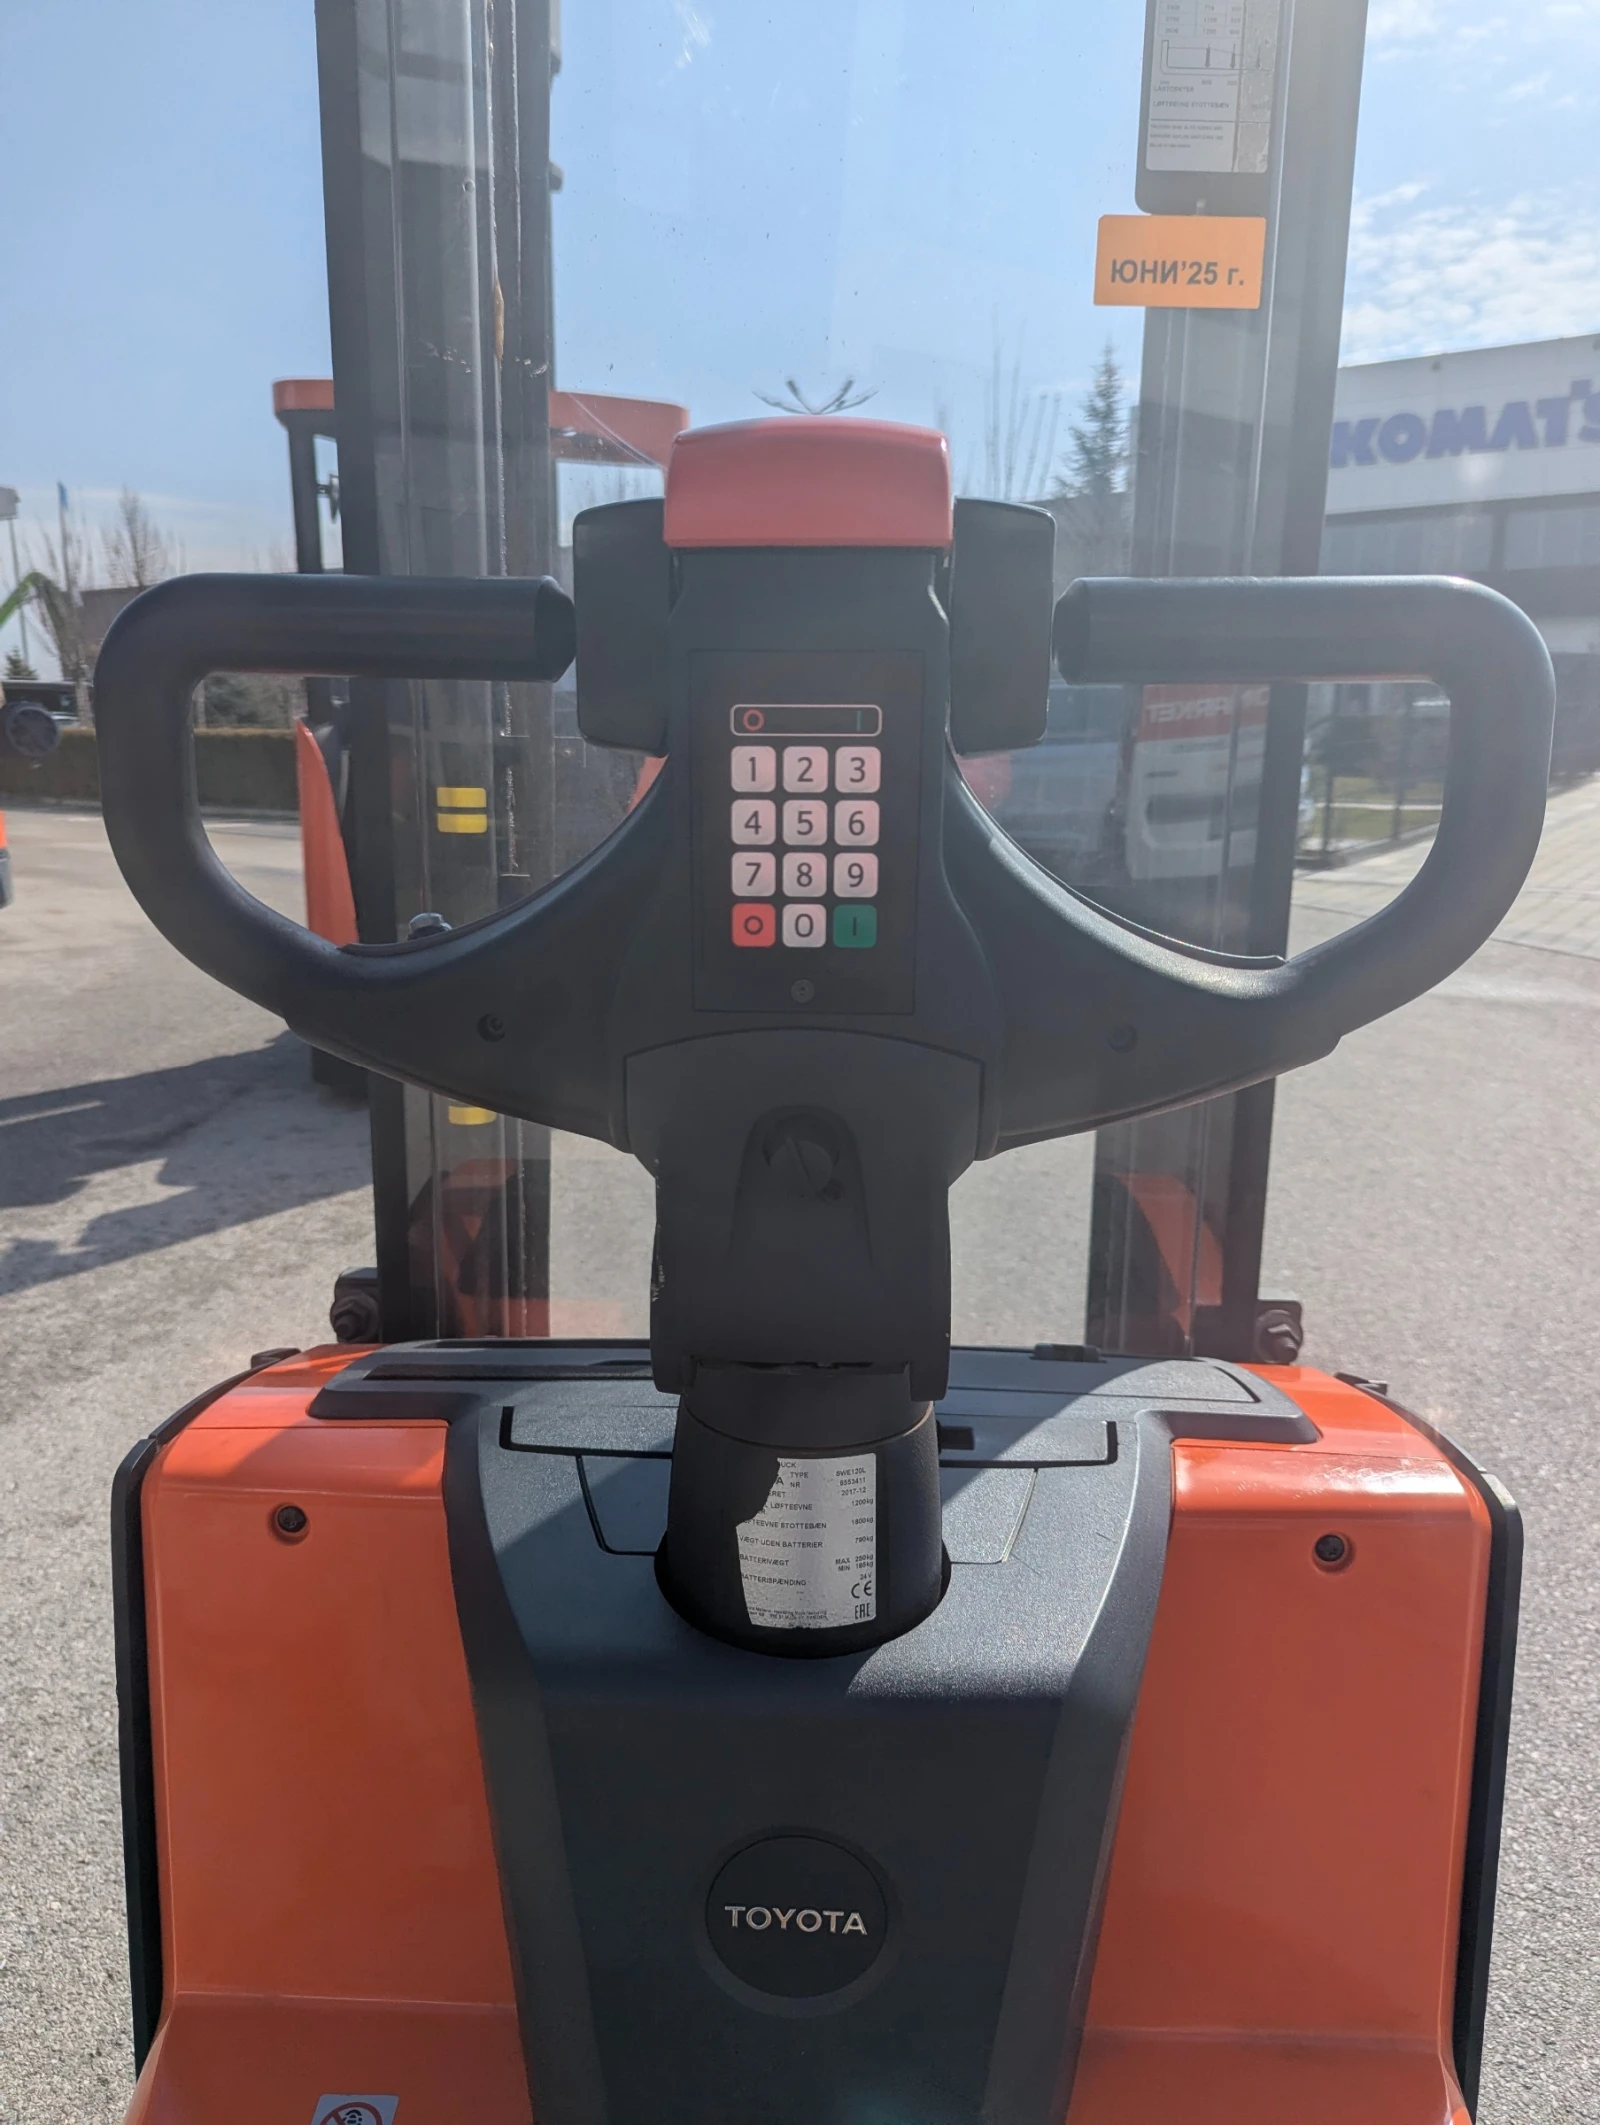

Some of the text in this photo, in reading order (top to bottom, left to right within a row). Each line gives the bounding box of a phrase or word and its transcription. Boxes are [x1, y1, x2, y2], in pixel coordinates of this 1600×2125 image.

[749, 756, 865, 783] 1 2 3
[744, 810, 865, 835] 4 5 6
[745, 862, 864, 887] 7 8 9
[795, 913, 814, 937] 0
[790, 1471, 809, 1479] TYPE
[841, 1486, 867, 1496] 2017-12
[760, 1539, 781, 1547] UDEN
[782, 1541, 824, 1549] BATTERIER
[835, 1557, 850, 1566] MAX
[724, 1905, 868, 1936] TOYOTA
